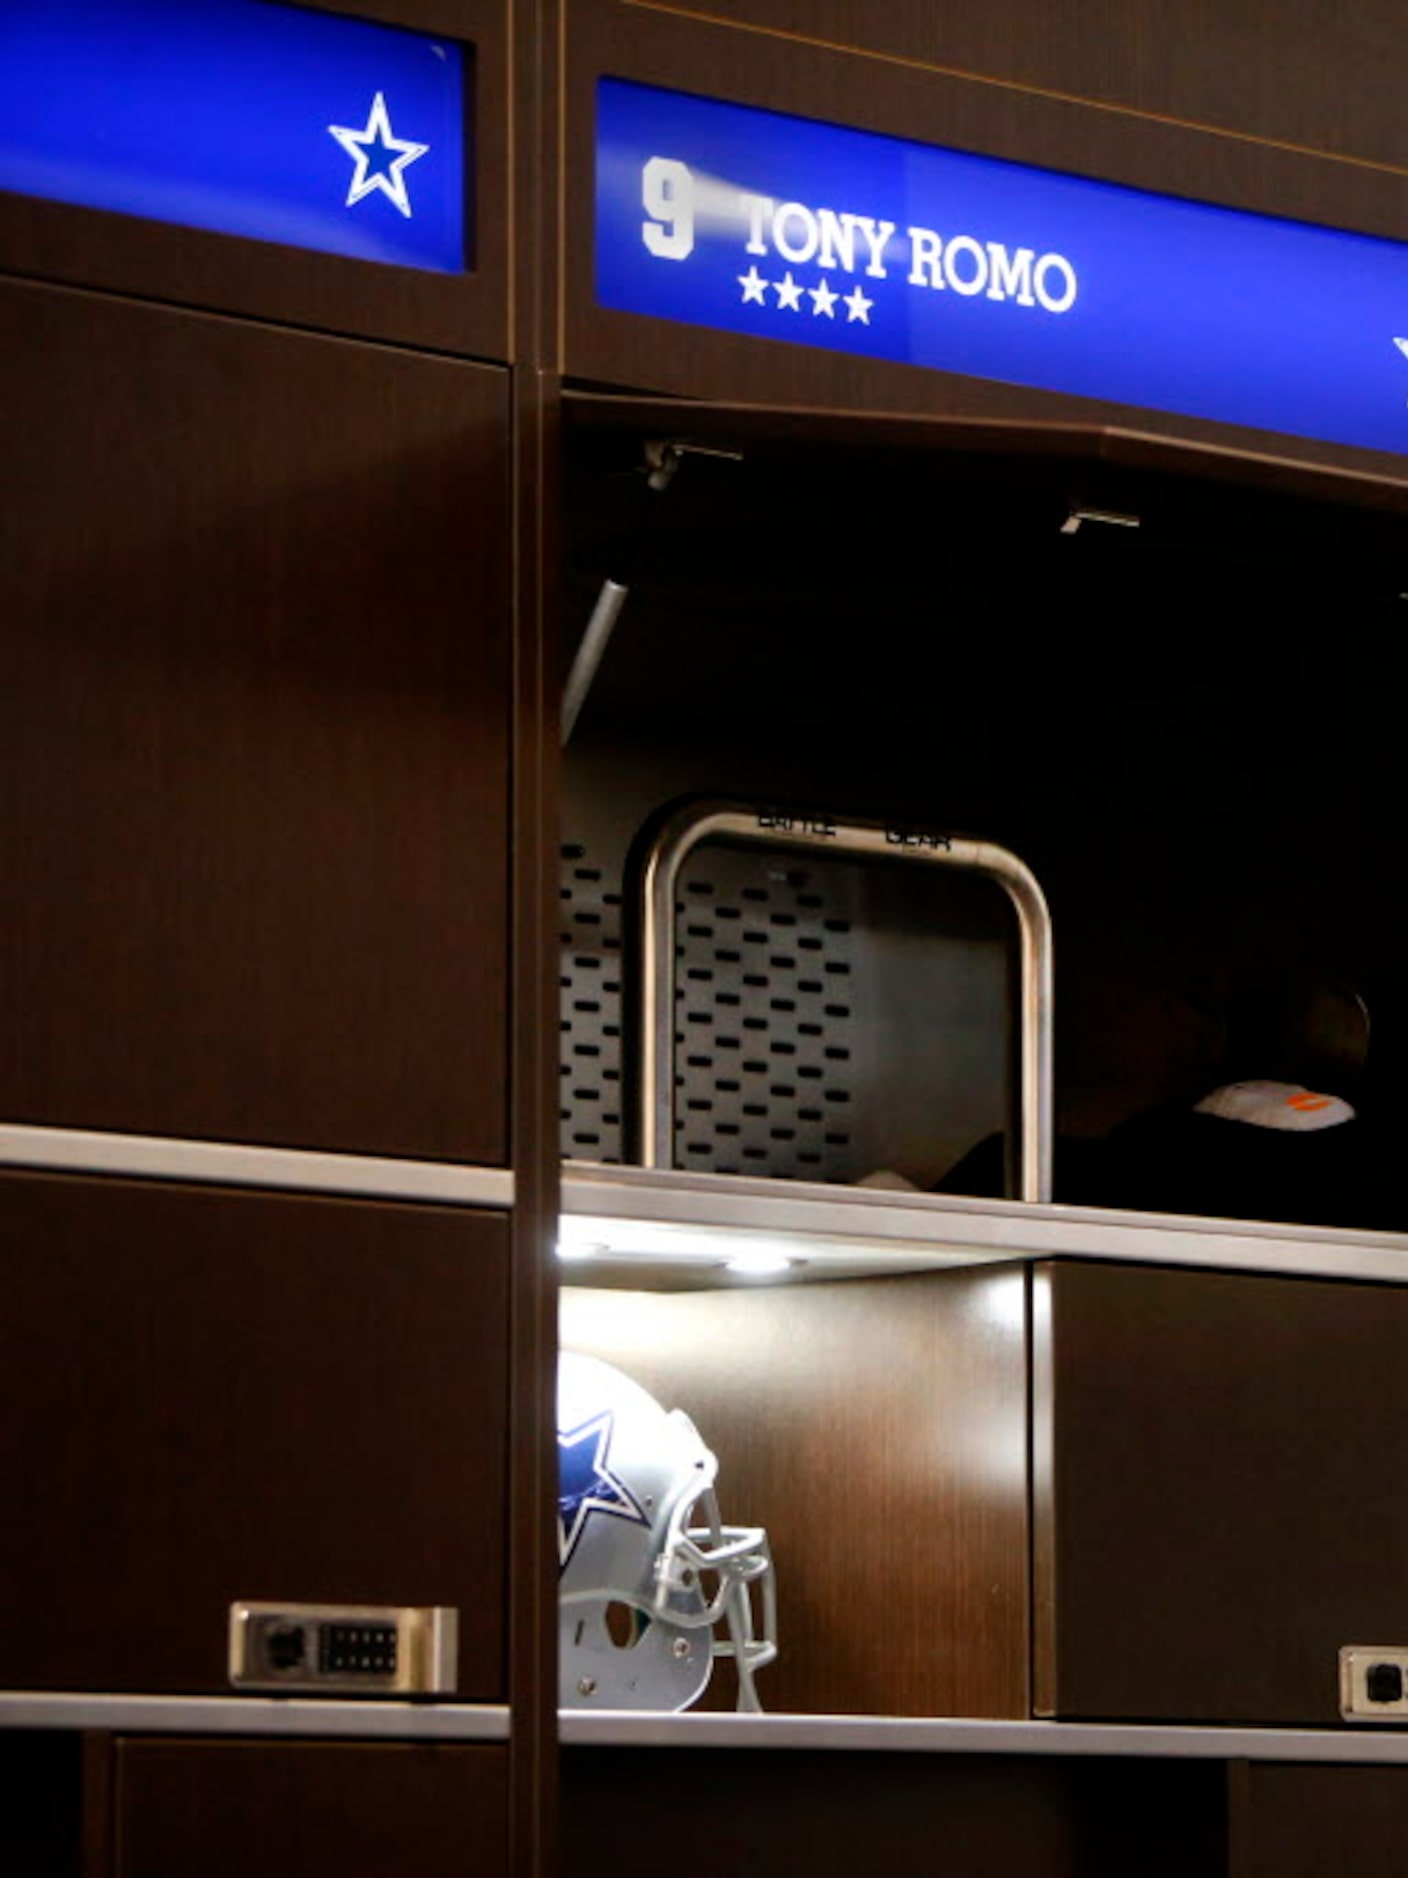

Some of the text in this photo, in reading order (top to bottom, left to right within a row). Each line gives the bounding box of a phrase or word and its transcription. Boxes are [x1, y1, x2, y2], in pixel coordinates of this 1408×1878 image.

[641, 155, 695, 262] 9
[739, 194, 1078, 314] TONY ROMO
